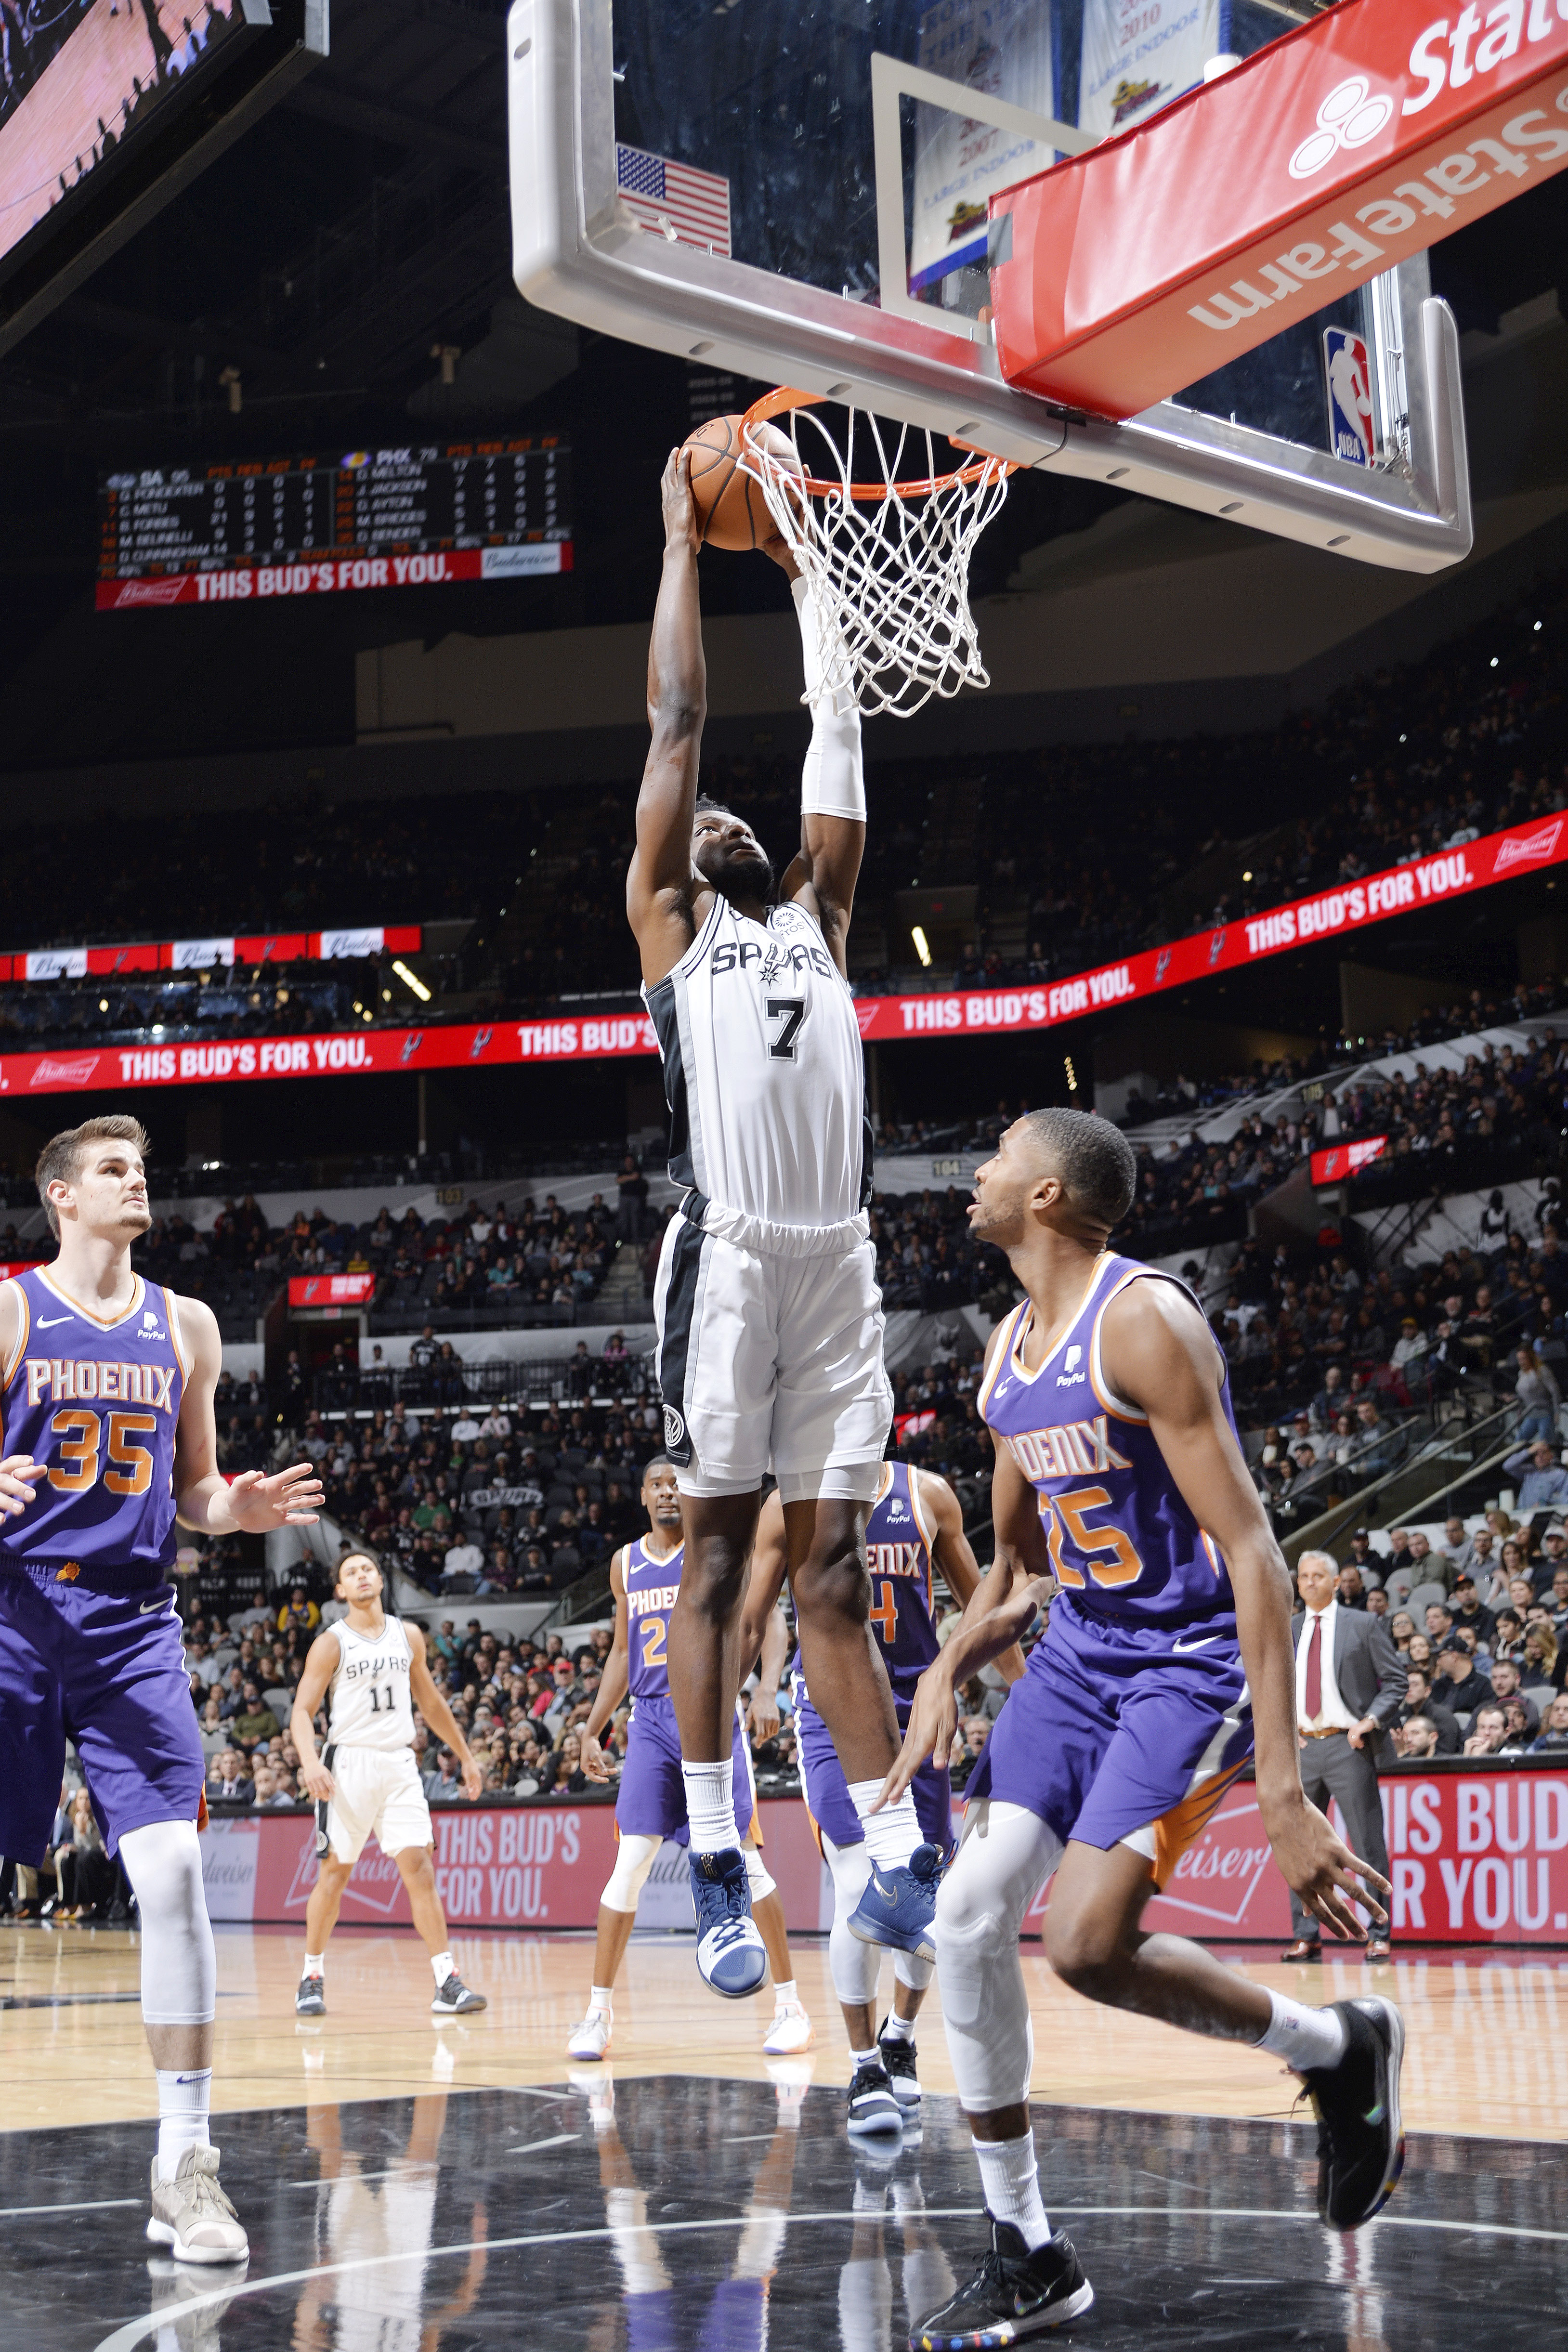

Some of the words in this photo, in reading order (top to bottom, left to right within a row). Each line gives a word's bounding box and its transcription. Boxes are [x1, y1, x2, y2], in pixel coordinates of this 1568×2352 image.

[1401, 0, 1568, 116] Stat
[1338, 431, 1361, 460] NBA
[195, 569, 253, 602] THIS
[257, 562, 335, 597] BUD'S
[337, 559, 387, 589] FOR
[392, 553, 453, 585] YOU.
[1244, 909, 1296, 954] THIS
[1297, 886, 1367, 938] BUD'S
[1367, 872, 1415, 916] FOR
[1415, 852, 1474, 899] YOU.
[780, 921, 806, 939] fros
[712, 942, 834, 988] SPURS
[899, 998, 962, 1031] THIS
[965, 991, 1047, 1028] BUD'S
[1048, 979, 1088, 1018] FOR
[1087, 965, 1136, 1005] YOU.
[517, 1023, 578, 1056] THIS
[581, 1019, 658, 1052] BUD'S
[764, 997, 806, 1062] 7
[119, 1049, 176, 1082] THIS
[180, 1044, 256, 1078] BUD'S
[259, 1041, 310, 1073] FOR
[313, 1037, 374, 1070] YOU.
[137, 1329, 167, 1340] PayPal
[25, 1359, 176, 1415] PHOENIX
[1057, 1371, 1085, 1387] PayPal
[47, 1409, 157, 1496] 35
[640, 1617, 671, 1667] 2
[346, 1656, 408, 1679] SPURS
[370, 1686, 396, 1712] 11
[437, 1815, 494, 1865] THIS
[498, 1812, 581, 1865] BUD'S
[435, 1867, 483, 1917] FOR
[488, 1867, 549, 1918] YOU.
[1438, 1856, 1568, 1930] YOU.
